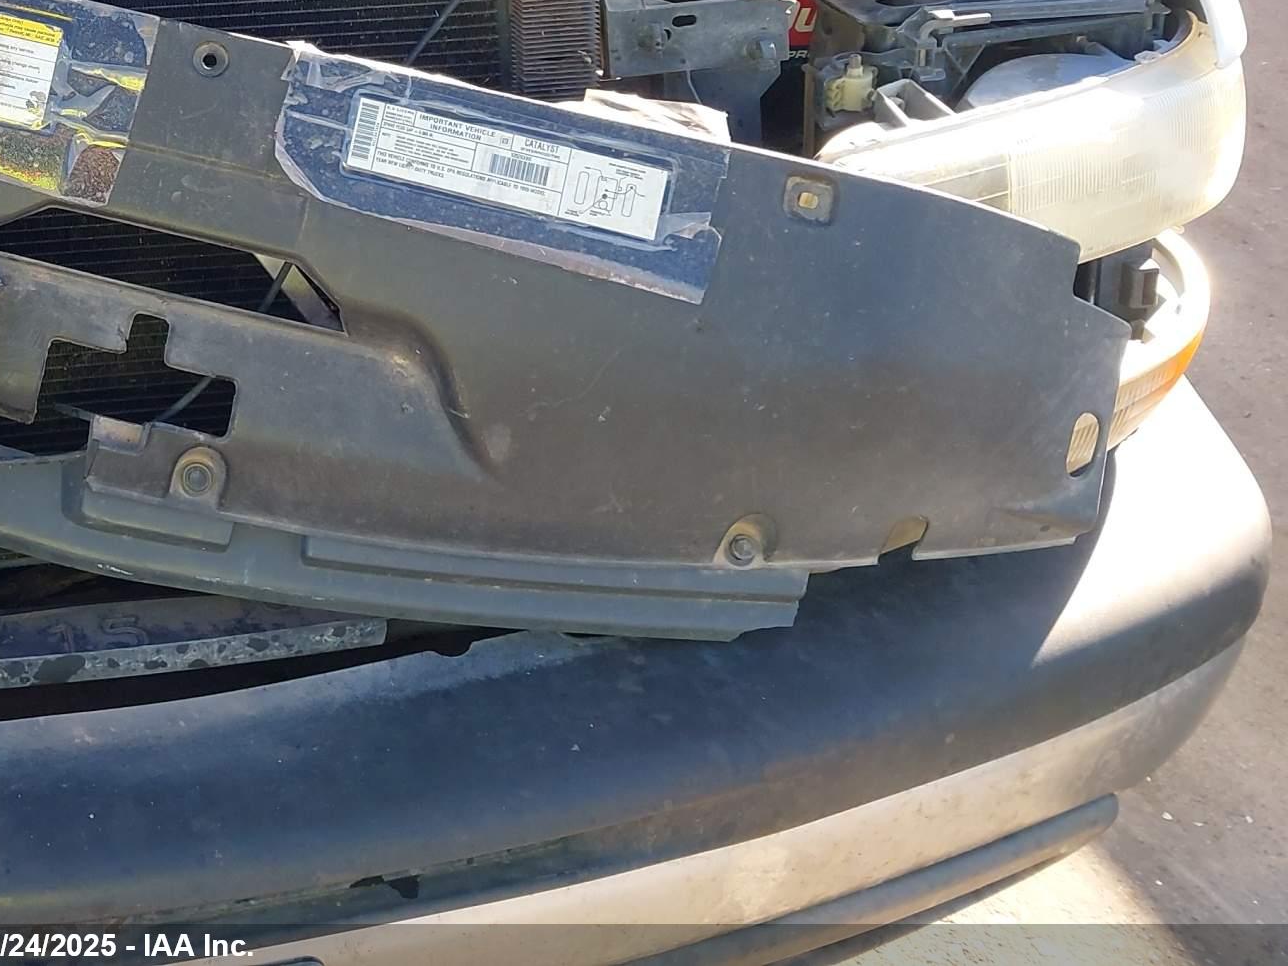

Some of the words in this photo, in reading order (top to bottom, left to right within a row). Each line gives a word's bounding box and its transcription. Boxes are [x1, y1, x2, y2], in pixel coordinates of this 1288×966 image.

[419, 113, 462, 128] IMPORTANT
[464, 125, 496, 137] VEHICLE
[430, 124, 481, 141] INFORMATION
[524, 139, 560, 154] CATALYST
